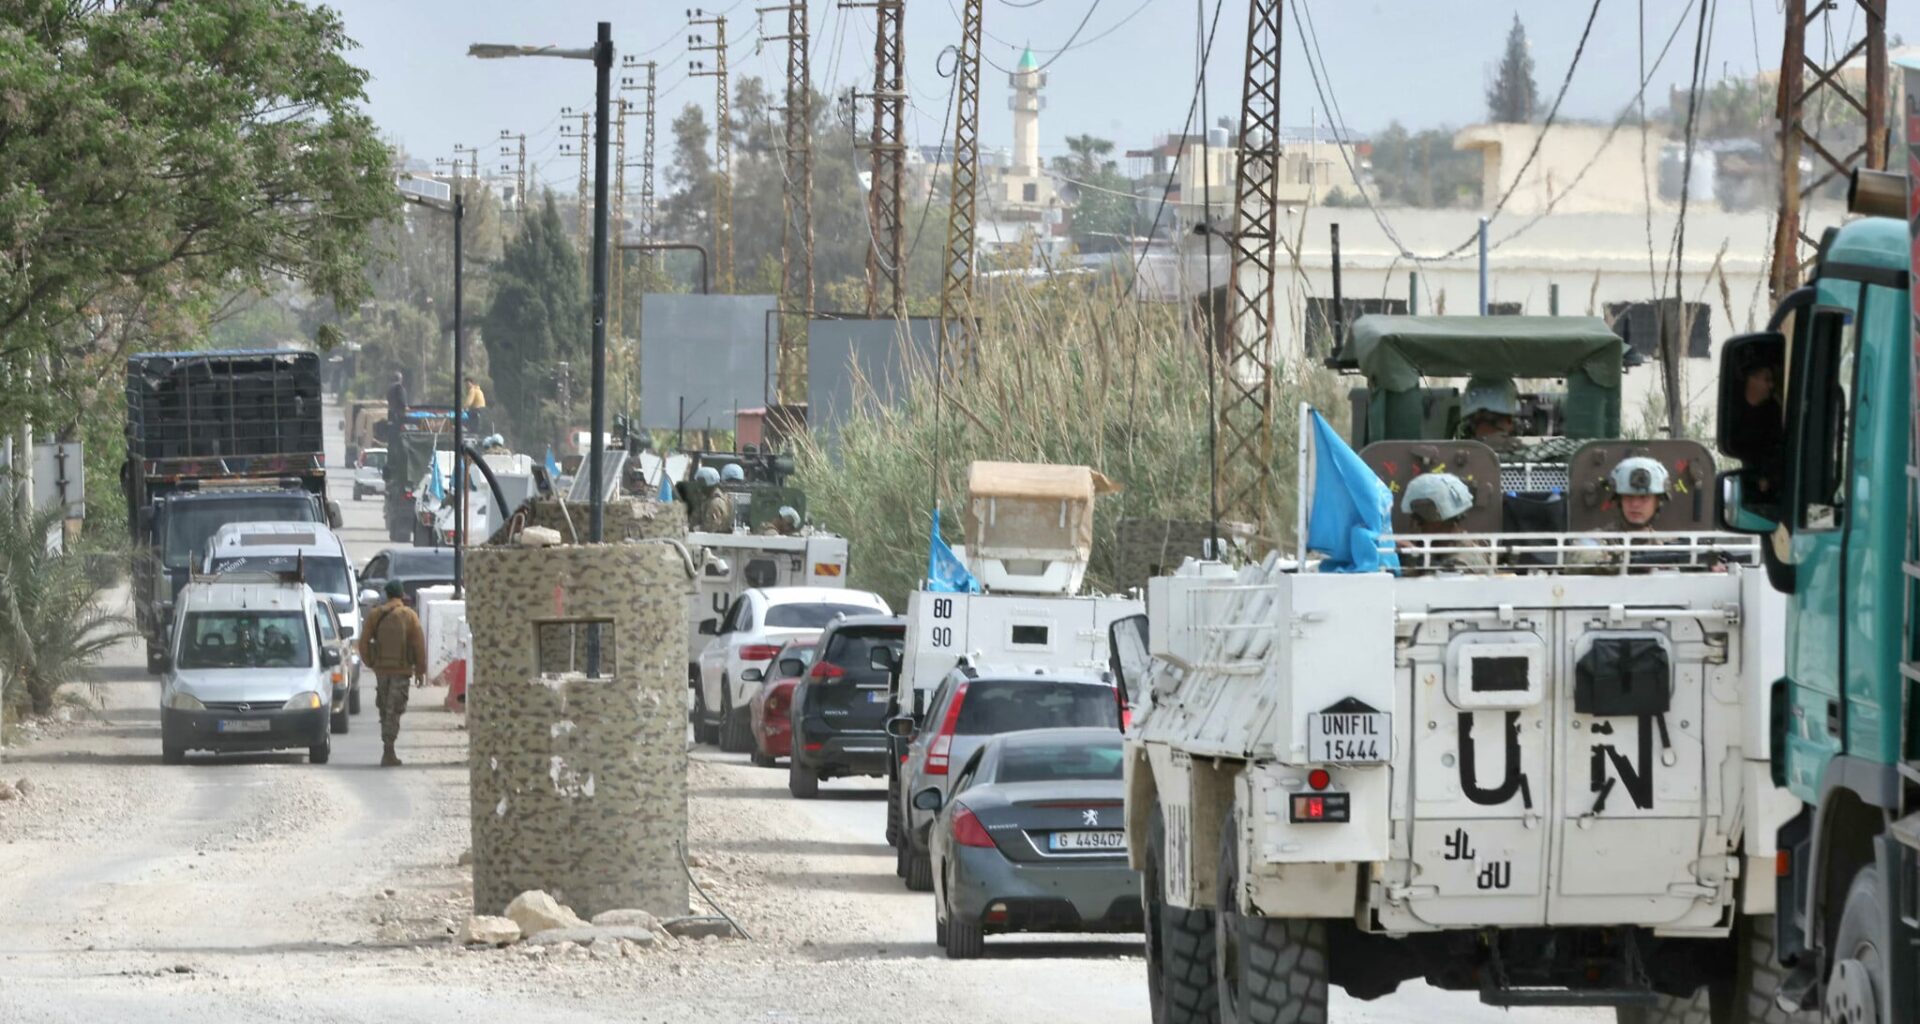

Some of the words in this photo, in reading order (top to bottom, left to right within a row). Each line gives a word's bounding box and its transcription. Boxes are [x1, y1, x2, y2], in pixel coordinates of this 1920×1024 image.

[933, 598, 952, 619] 80
[932, 627, 952, 648] 90
[1322, 714, 1378, 736] UNIFIL
[1325, 740, 1378, 760] 15444
[1059, 833, 1069, 847] G
[1076, 833, 1124, 847] 449407
